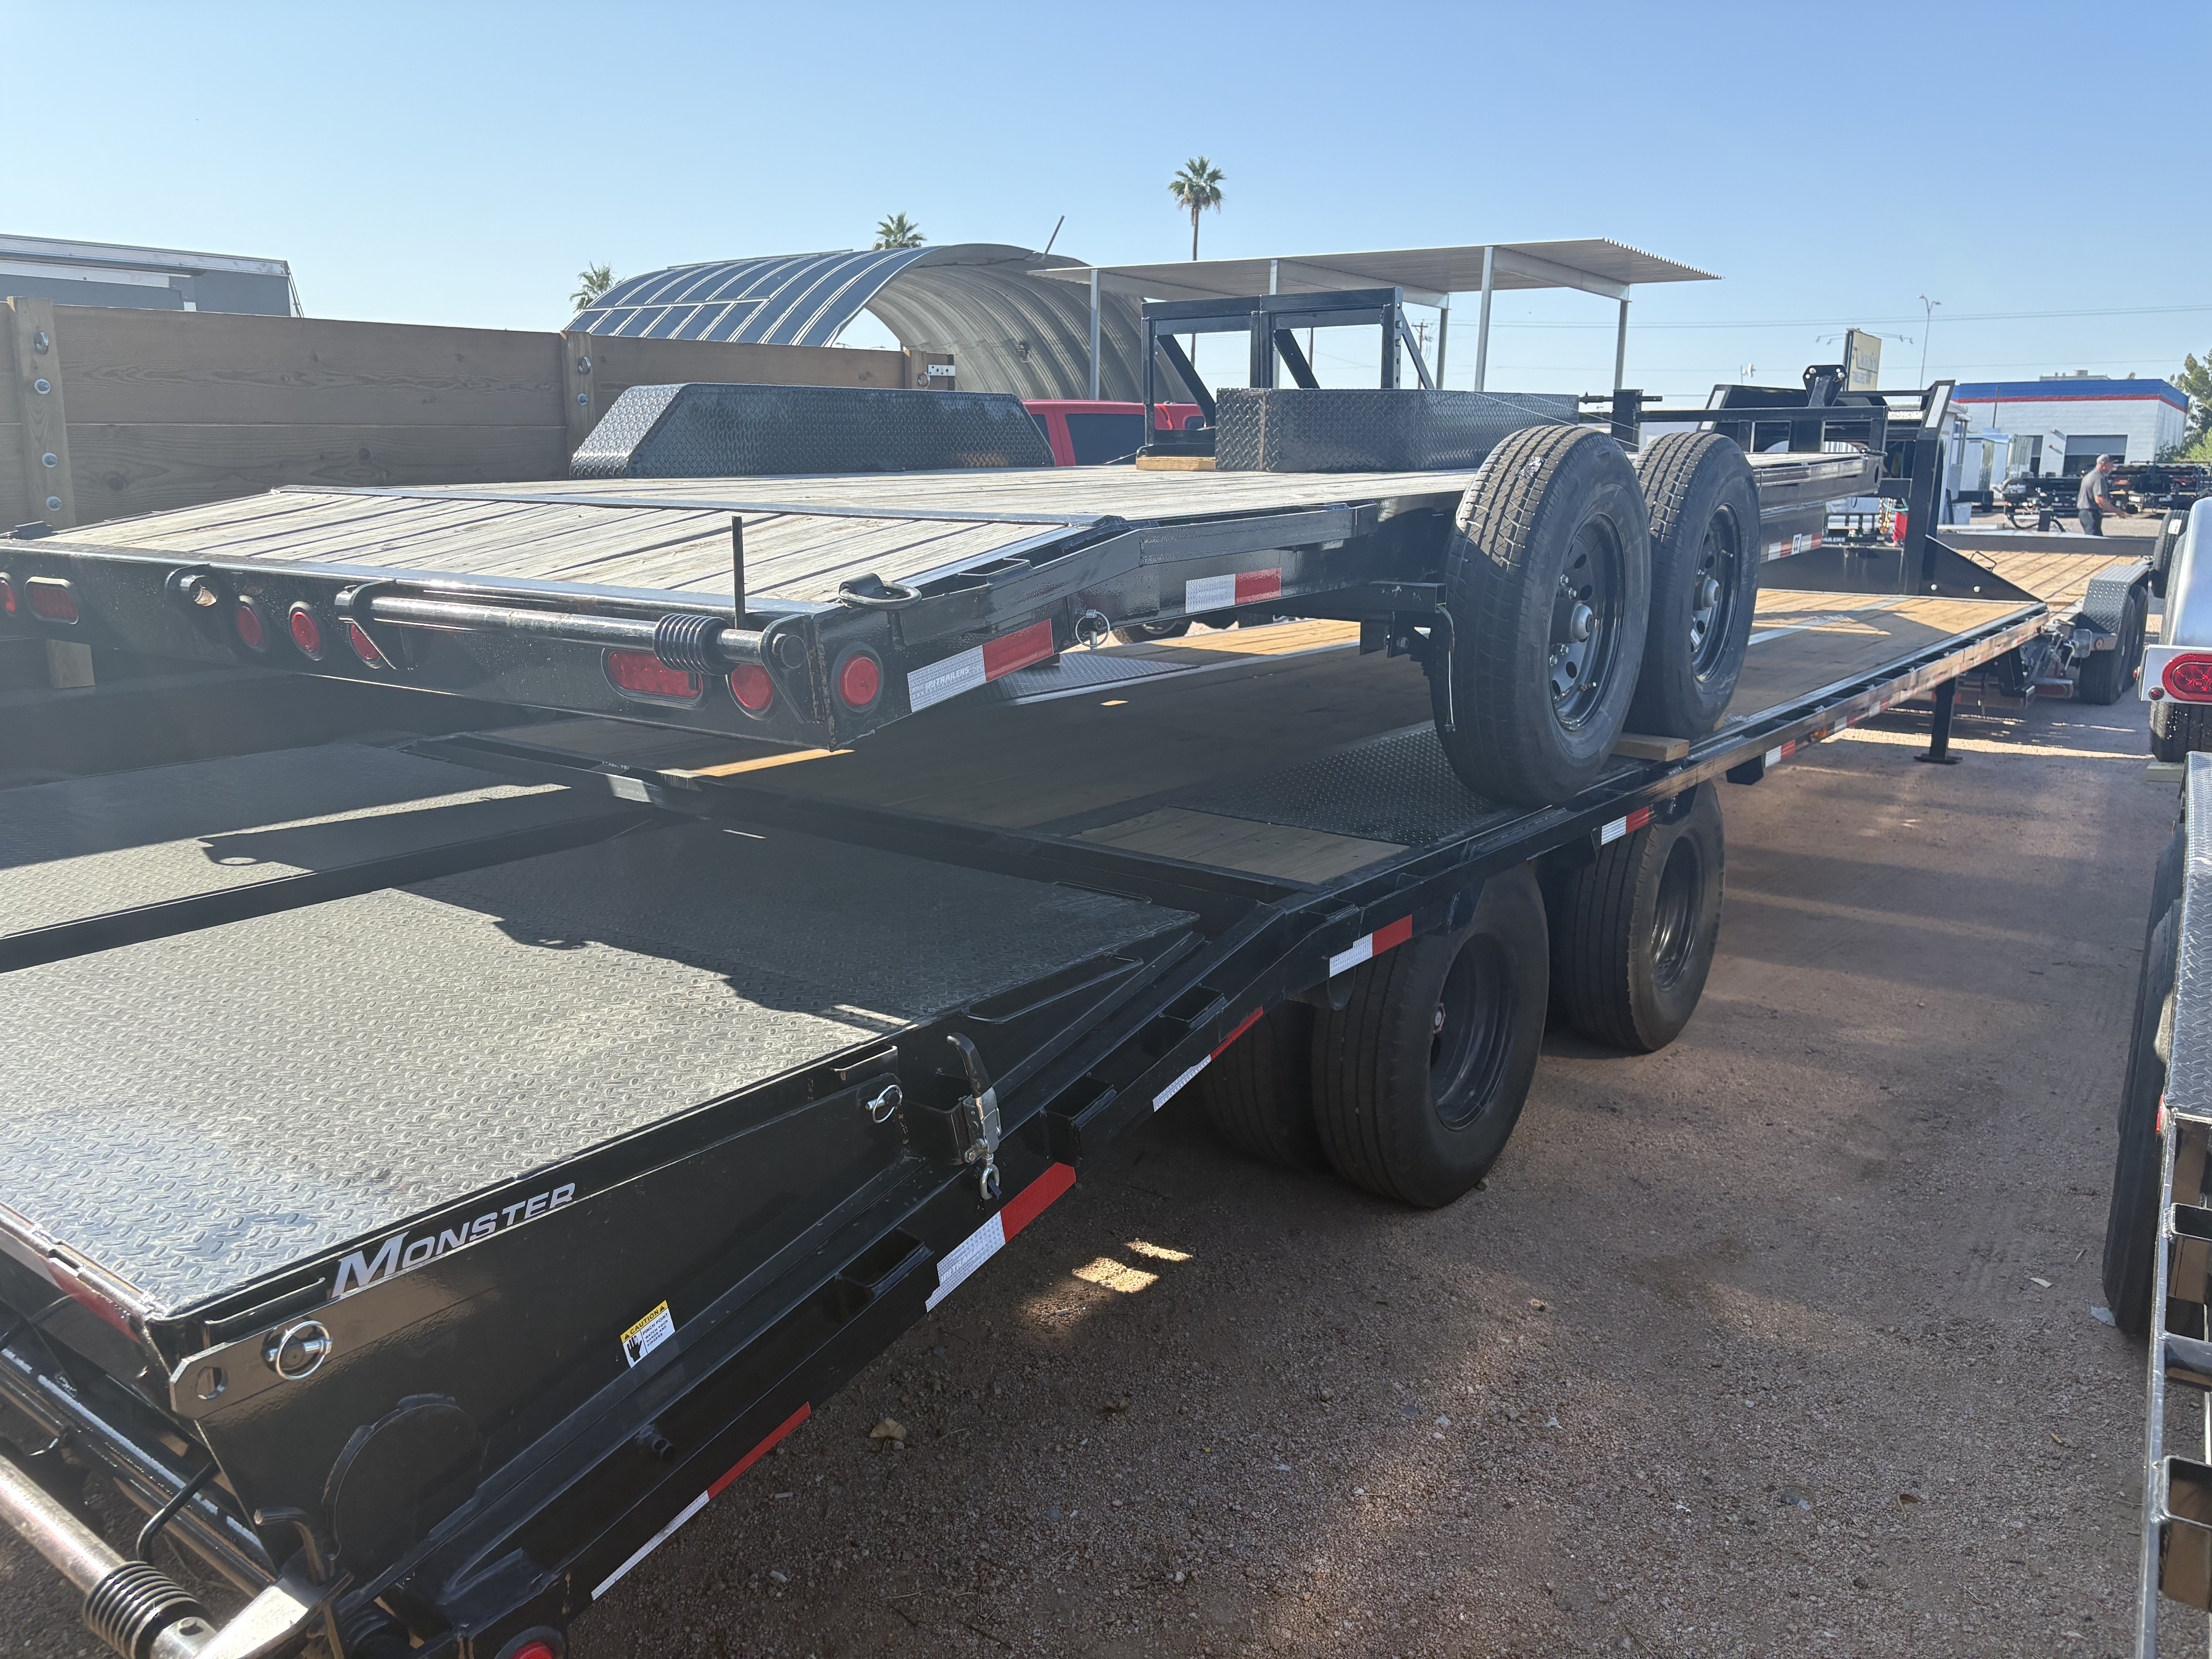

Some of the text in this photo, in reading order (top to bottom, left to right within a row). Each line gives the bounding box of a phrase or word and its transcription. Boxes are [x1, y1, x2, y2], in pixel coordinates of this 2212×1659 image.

[630, 1309, 659, 1334] CAUTION
[643, 1313, 668, 1335] PINCH POINT
[645, 1320, 668, 1339] WATCH YOUR
[646, 1333, 658, 1343] HANDS
[647, 1333, 663, 1346] FINGERS
